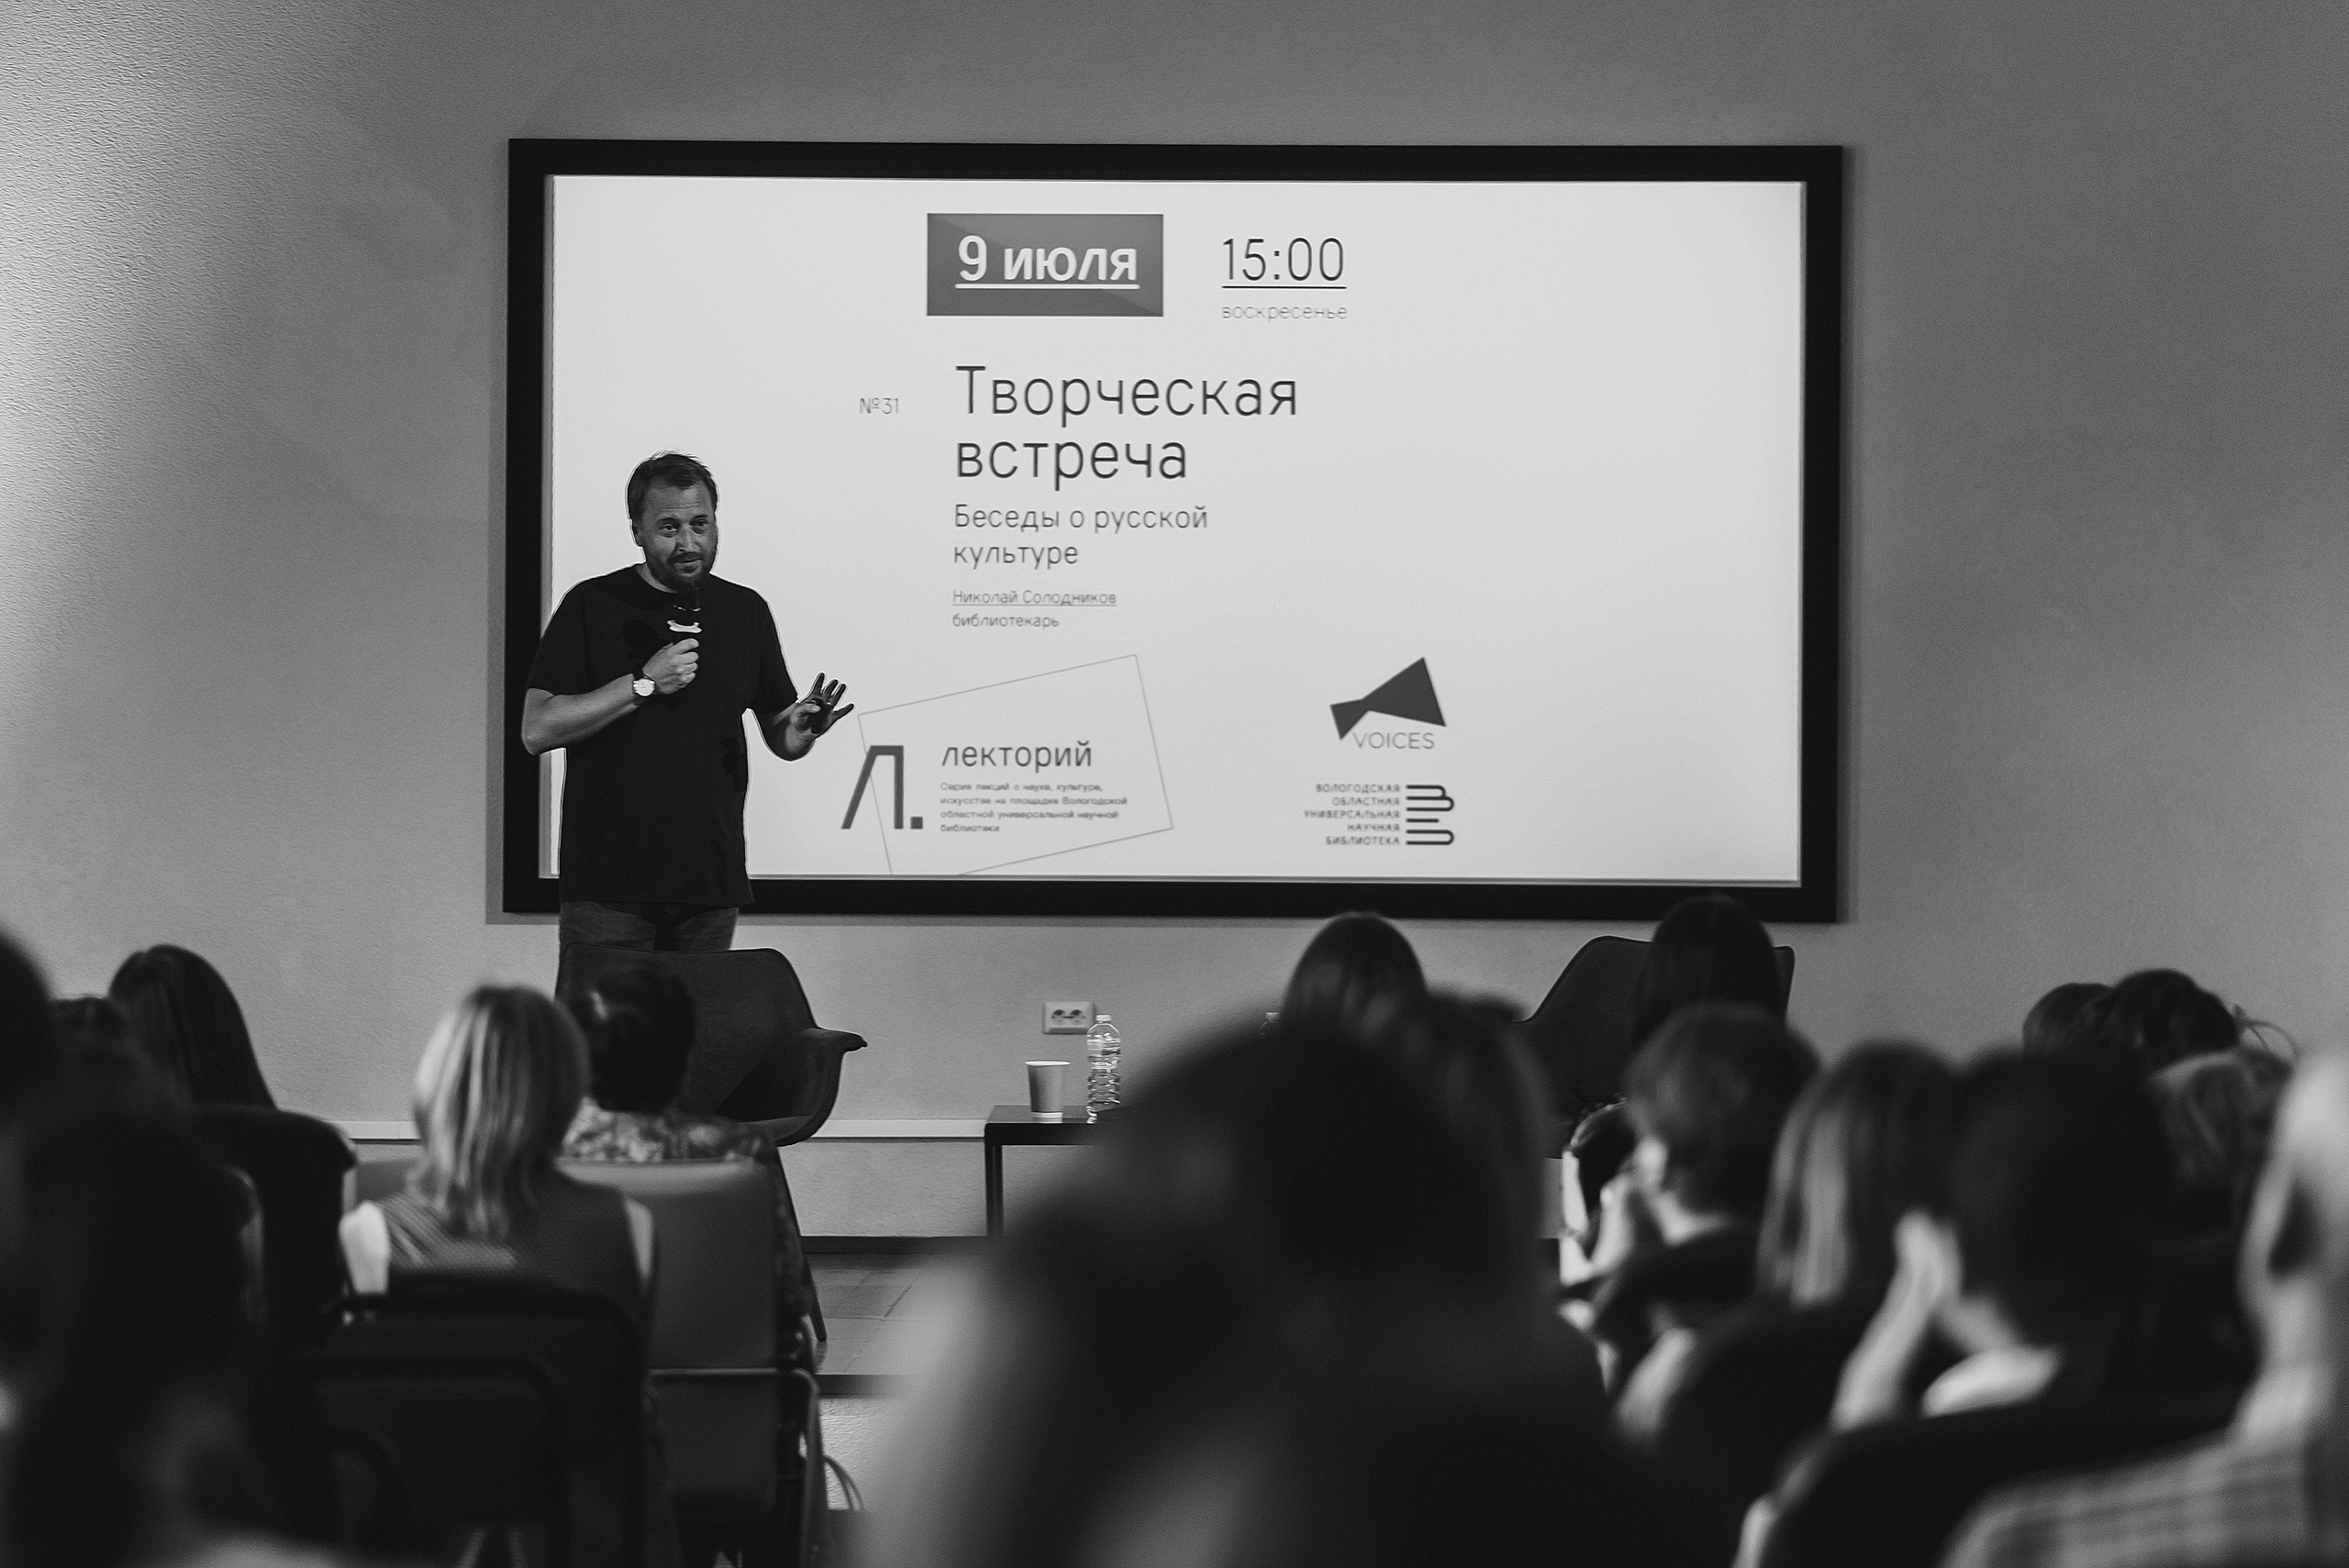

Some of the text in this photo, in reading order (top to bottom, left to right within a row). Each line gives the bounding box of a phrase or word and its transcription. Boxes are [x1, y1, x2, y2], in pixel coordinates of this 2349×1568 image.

[958, 234, 1138, 282] 9 июля
[1223, 237, 1344, 282] 15:00
[1221, 306, 1348, 320] воскресенье
[859, 396, 899, 416] №31
[955, 365, 1297, 428] Творческая
[957, 440, 1186, 492] встреча
[954, 503, 1208, 535] Беседы о русской
[953, 545, 1079, 571] культуре
[952, 589, 1118, 604] Николай Солодников
[952, 612, 1060, 629] библиотекарь
[1353, 731, 1436, 751] VOICES
[941, 740, 1093, 773] лекторий
[1315, 783, 1401, 795] ВОЛОГОДСКАЯ
[1331, 796, 1401, 806] ОБЛАСТНАЯ
[1304, 809, 1401, 819] УНИВЕРСАЛЬНАЯ
[1347, 823, 1401, 832] НАУЧНАЯ
[1325, 835, 1400, 846] БИБЛИОТЕКА
